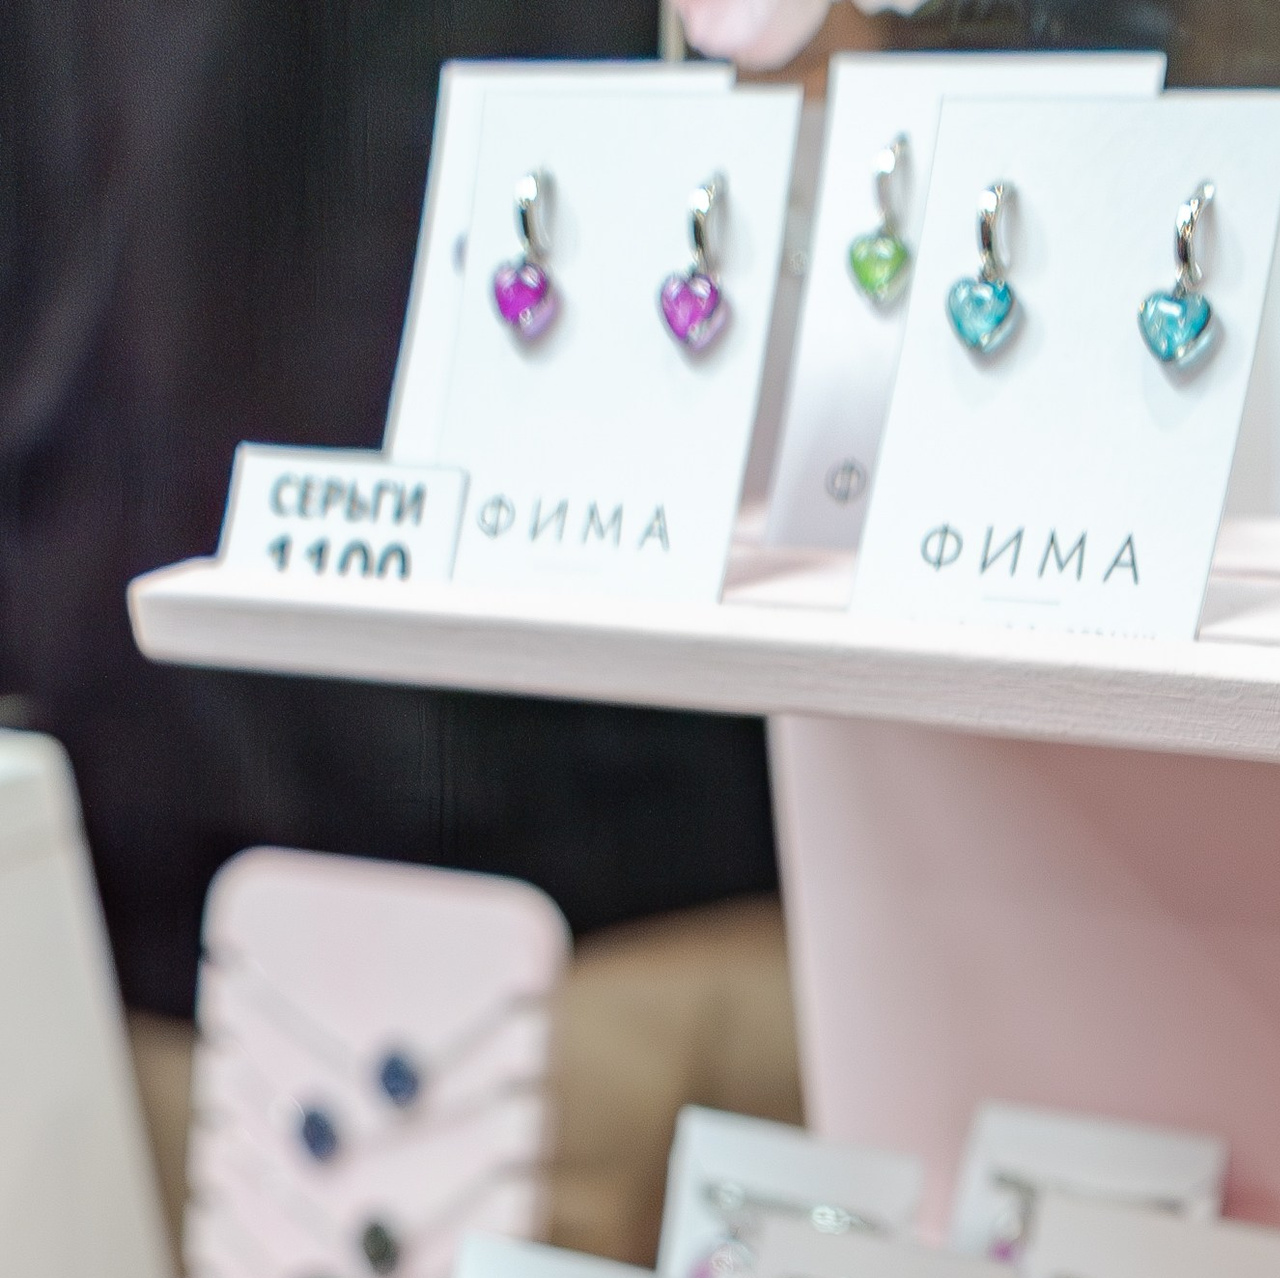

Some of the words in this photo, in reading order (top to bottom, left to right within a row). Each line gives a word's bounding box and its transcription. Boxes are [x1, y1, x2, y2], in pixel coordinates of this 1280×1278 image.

[269, 472, 427, 527] СЕРЬГИ
[477, 493, 671, 552] ФИМА
[919, 522, 1140, 587] ФИМА
